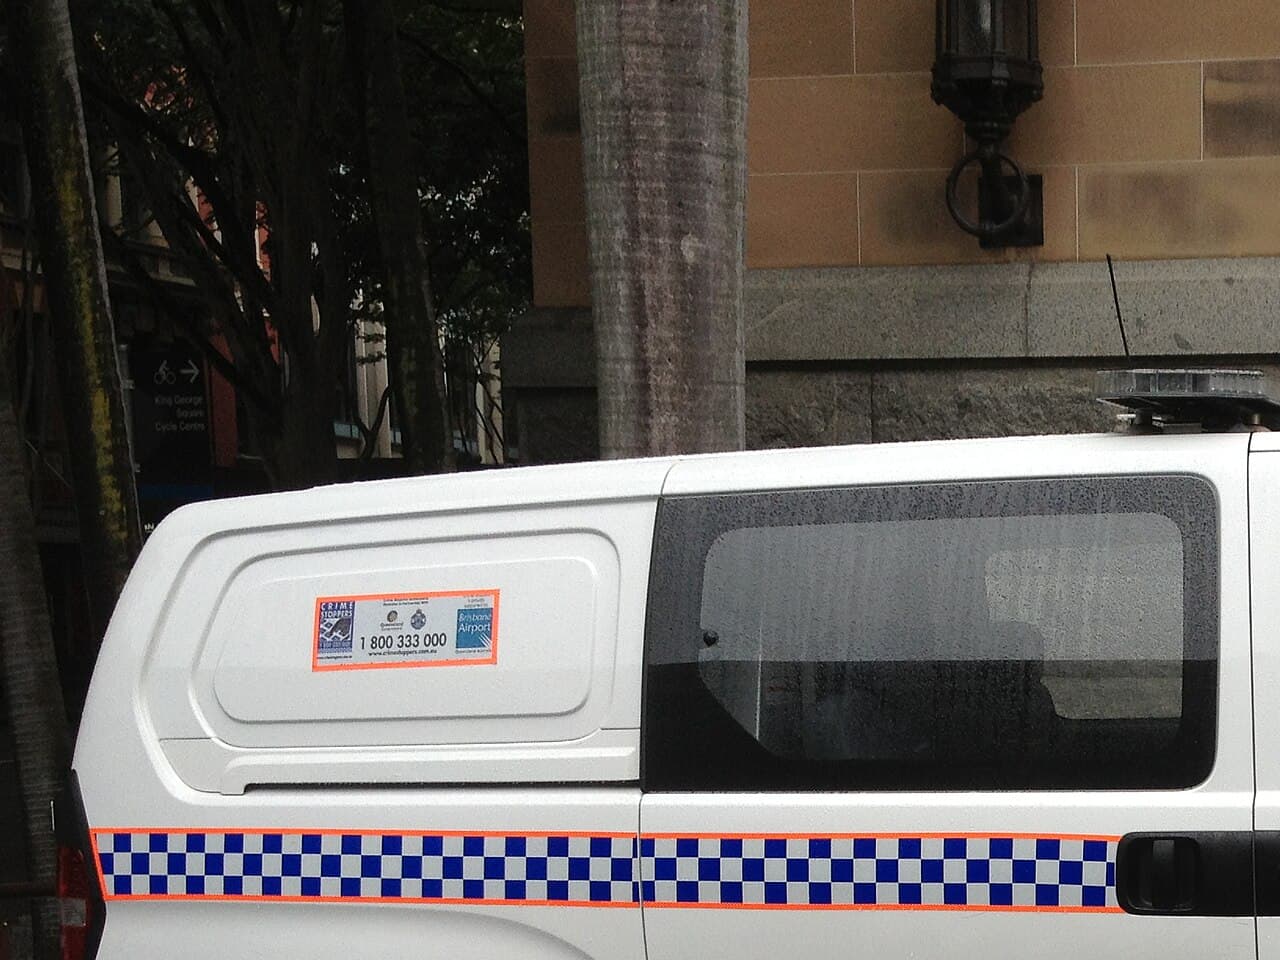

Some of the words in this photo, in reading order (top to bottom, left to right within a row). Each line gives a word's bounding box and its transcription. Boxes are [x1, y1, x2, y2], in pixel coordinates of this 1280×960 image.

[154, 395, 173, 407] King
[174, 394, 203, 407] George
[154, 421, 177, 433] Cycle
[179, 421, 206, 432] Centre
[321, 602, 353, 611] CRIME
[320, 610, 353, 619] STOPPERS
[458, 623, 491, 635] Airport
[360, 636, 366, 650] 1
[370, 635, 393, 650] 800
[397, 633, 420, 648] 333
[423, 632, 447, 647] 000
